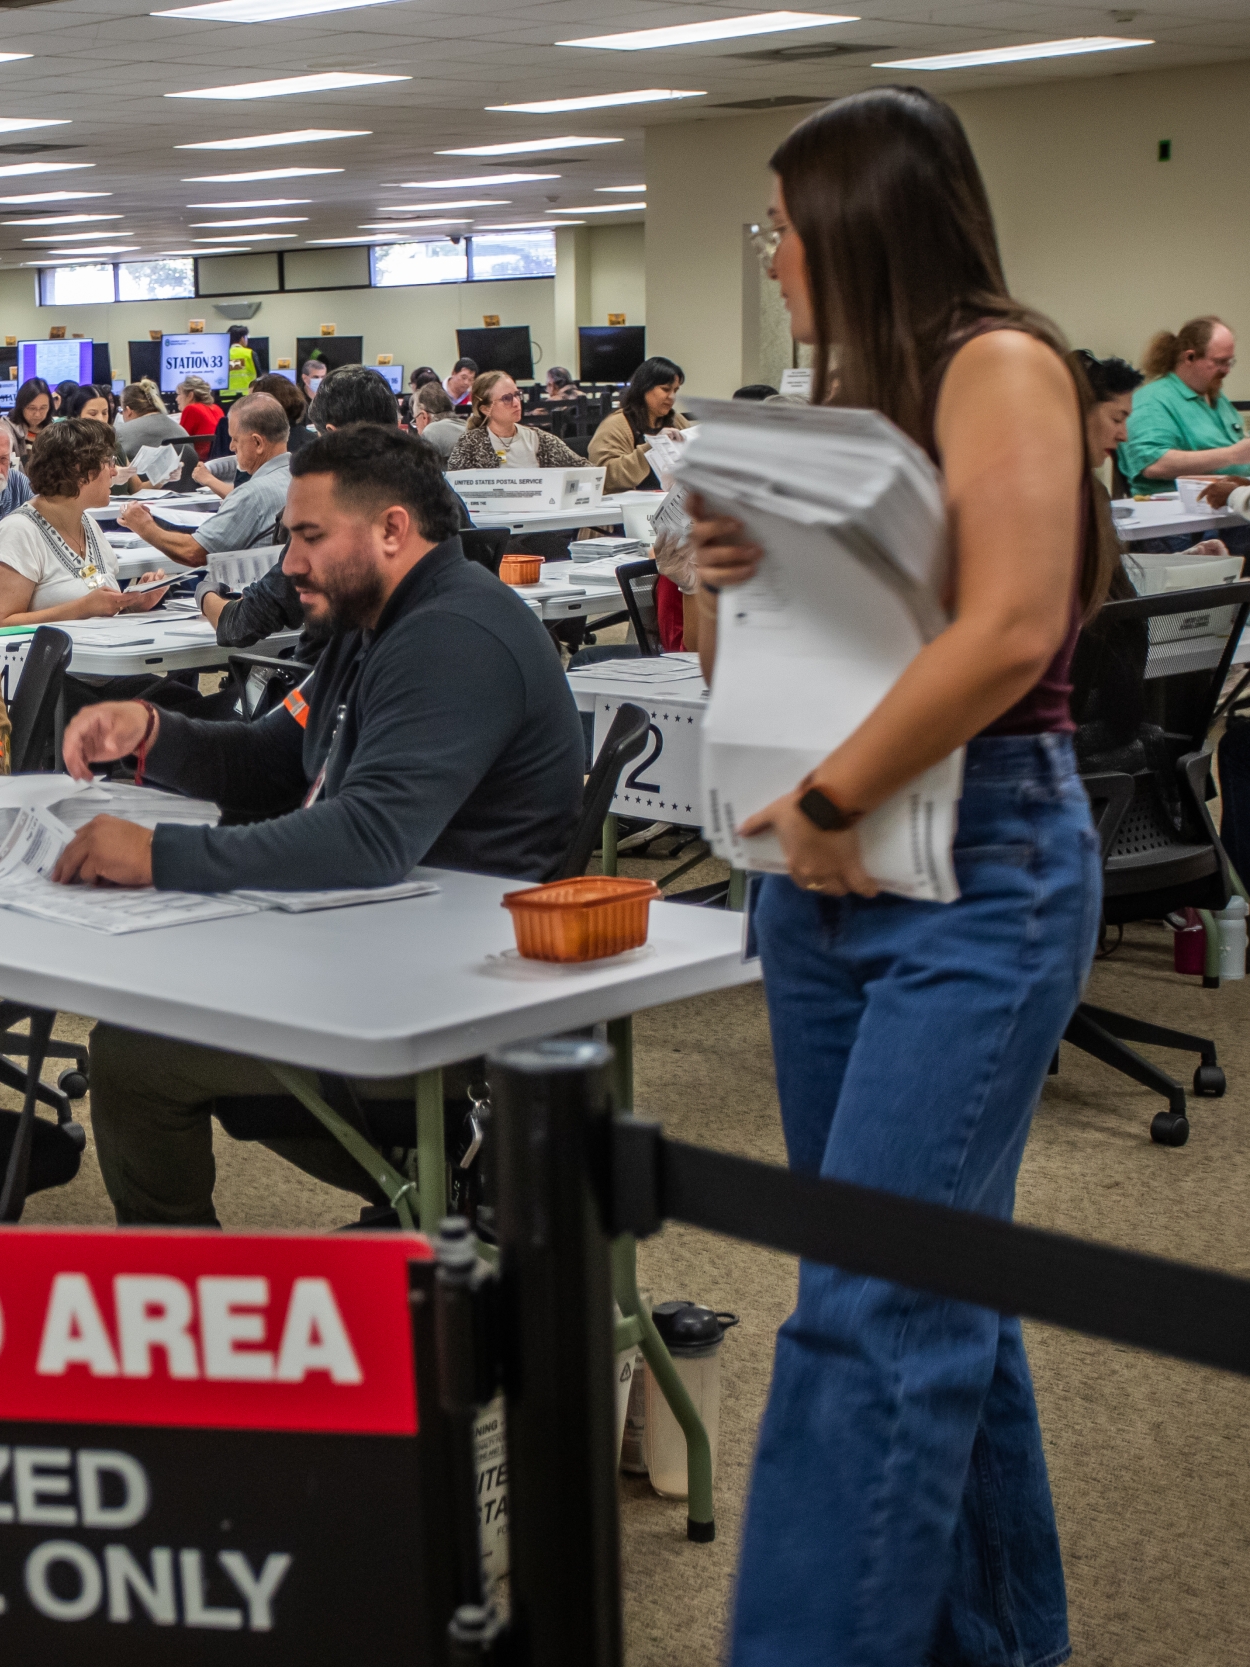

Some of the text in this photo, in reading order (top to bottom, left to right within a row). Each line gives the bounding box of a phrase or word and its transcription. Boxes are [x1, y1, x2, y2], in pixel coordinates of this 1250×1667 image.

[166, 355, 223, 370] STATION 33
[0, 664, 14, 706] 1
[625, 722, 664, 794] 2
[35, 1270, 364, 1386] AREA
[24, 1540, 292, 1632] ONLY
